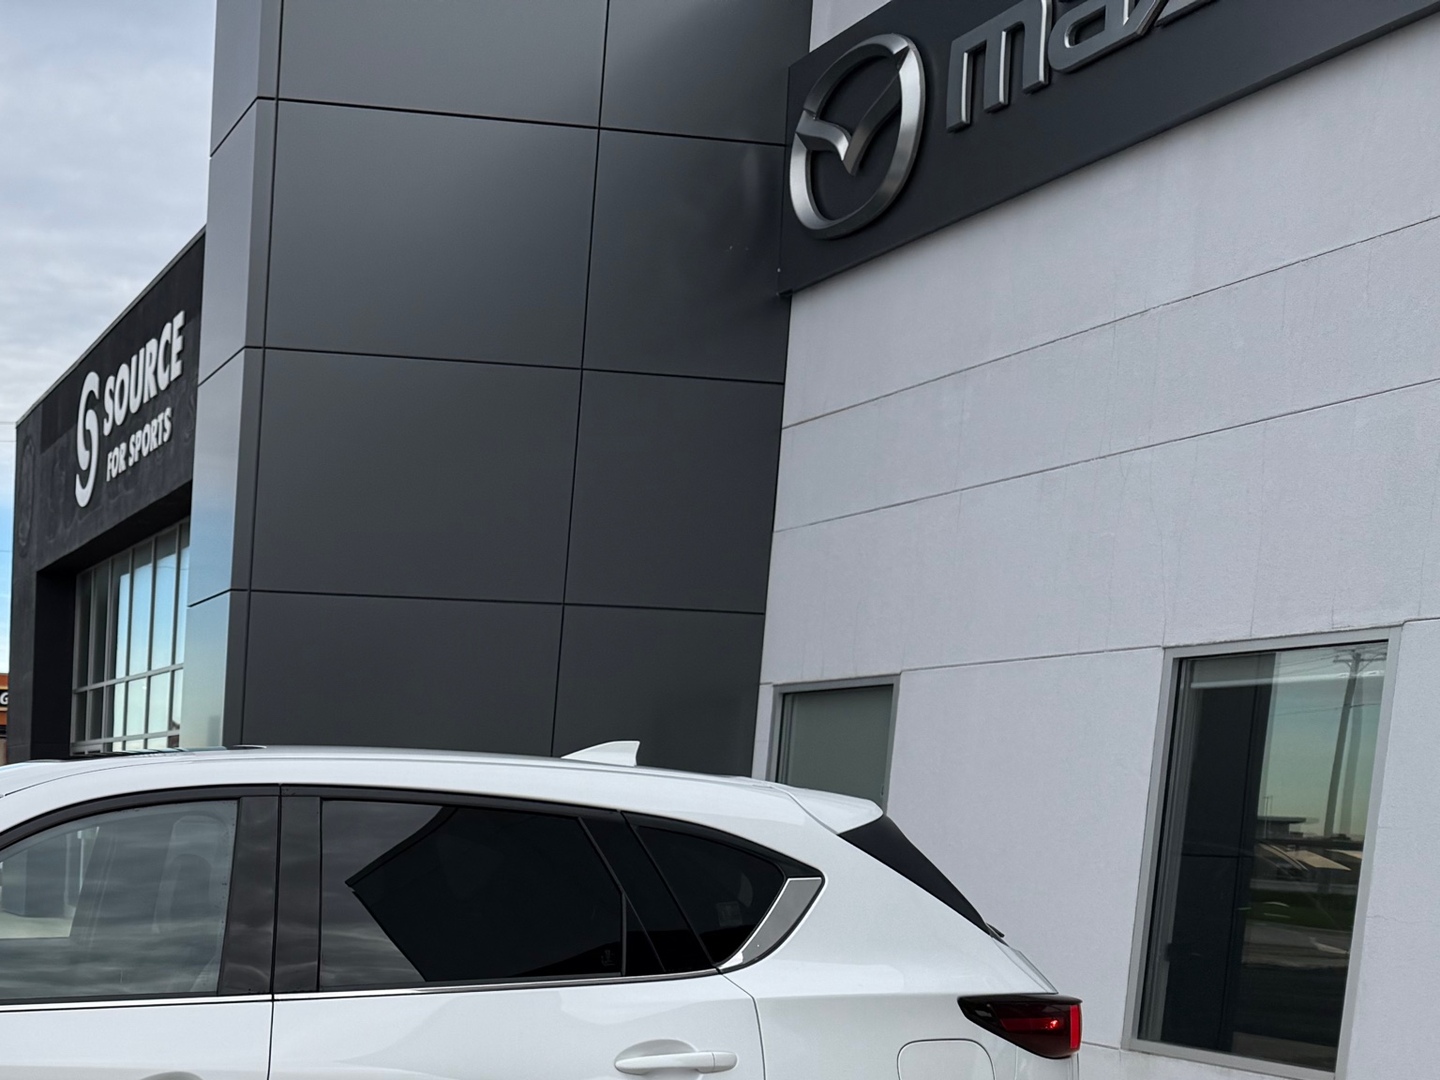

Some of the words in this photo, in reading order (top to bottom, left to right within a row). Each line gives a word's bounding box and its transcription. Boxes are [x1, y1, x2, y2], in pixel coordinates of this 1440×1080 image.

[103, 310, 185, 437] SOURCE
[106, 441, 127, 482] FOR
[128, 406, 172, 468] SPORTS
